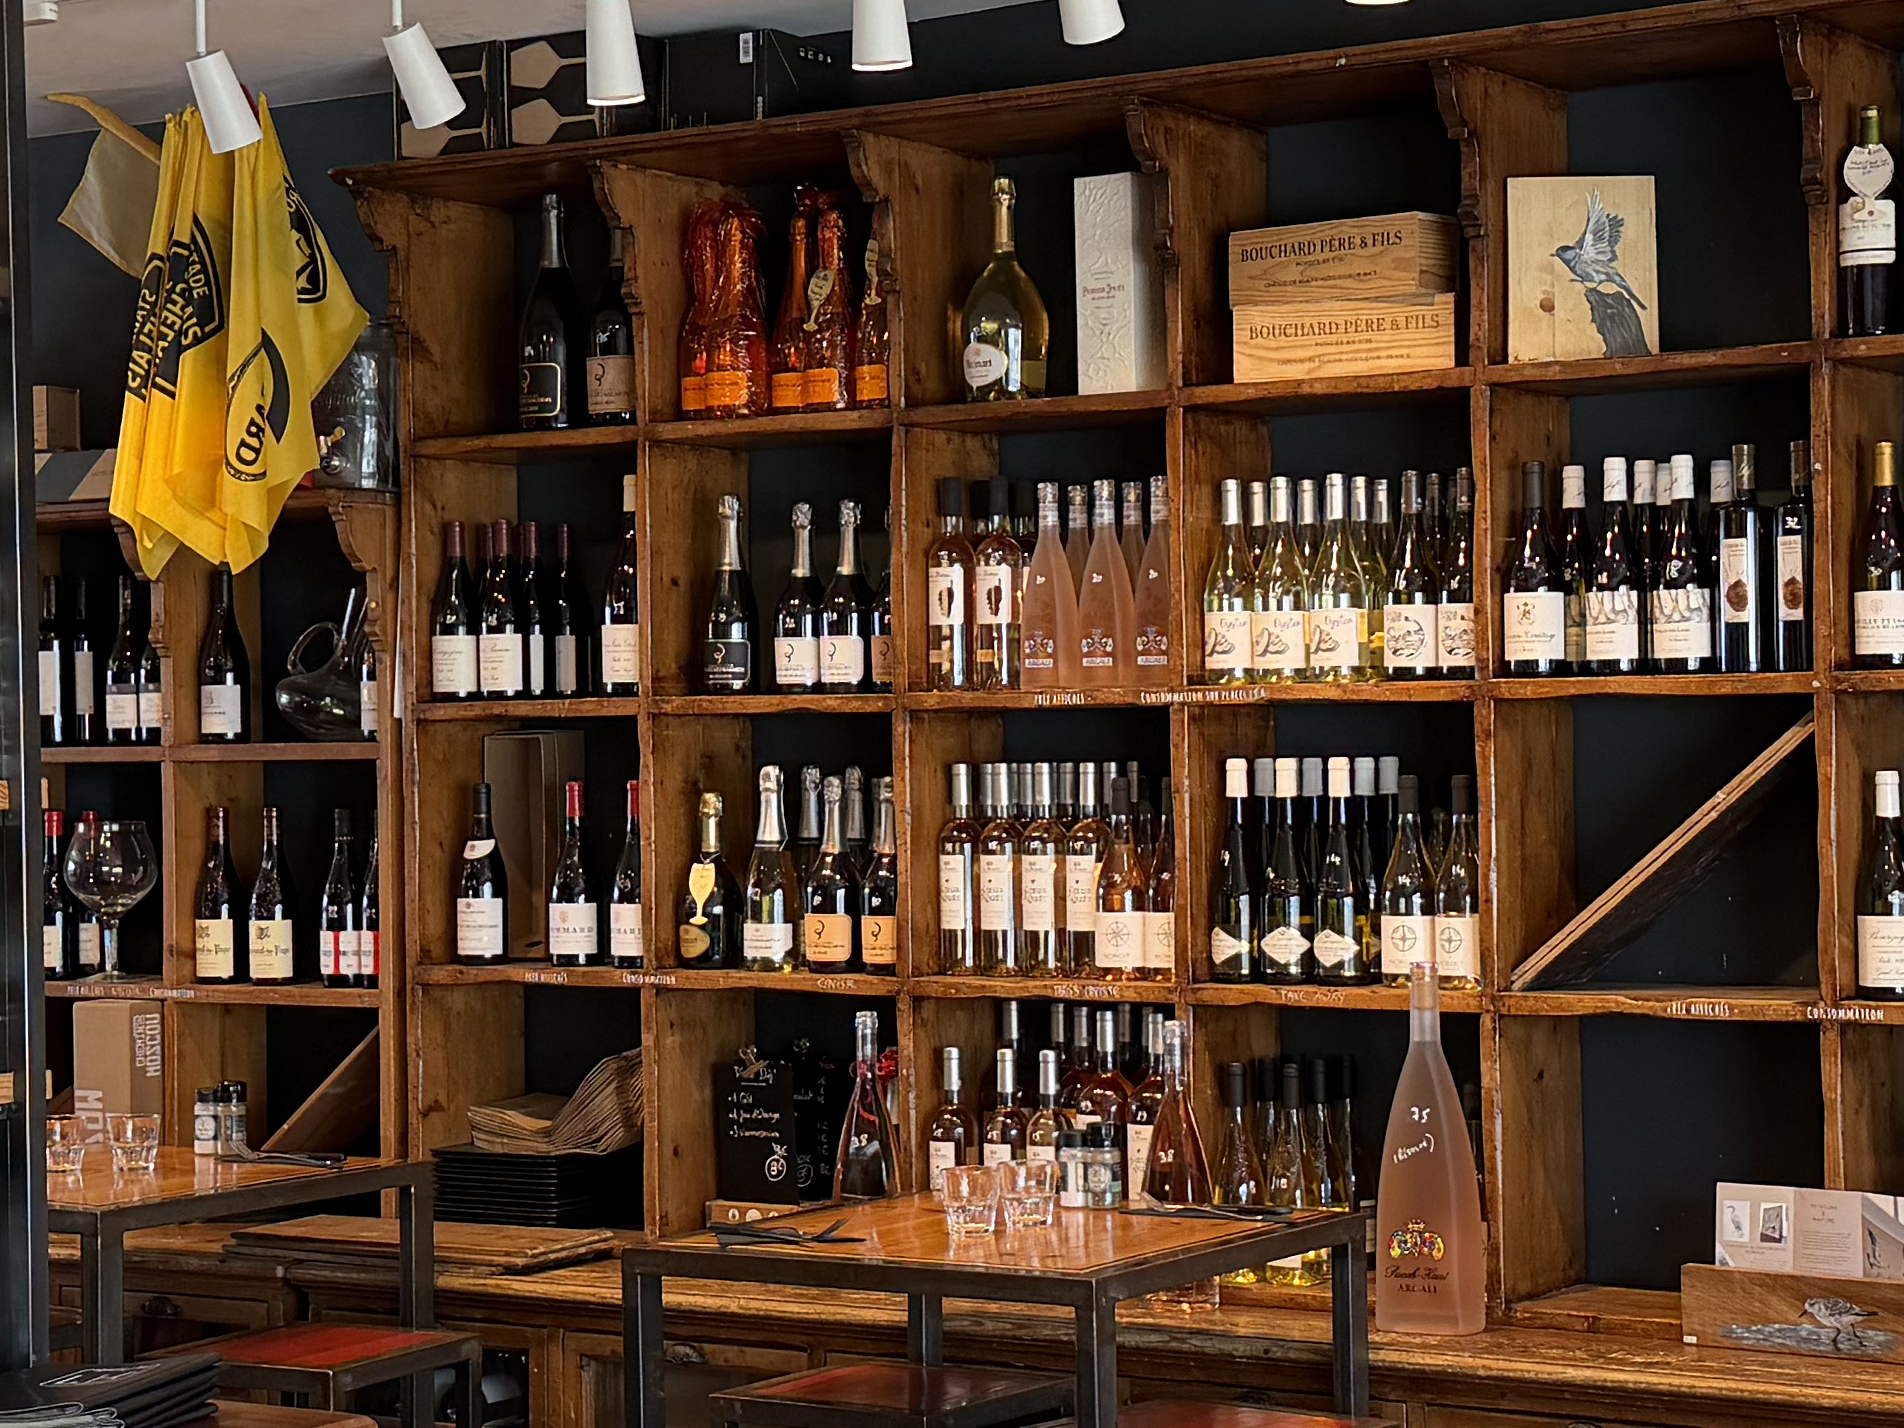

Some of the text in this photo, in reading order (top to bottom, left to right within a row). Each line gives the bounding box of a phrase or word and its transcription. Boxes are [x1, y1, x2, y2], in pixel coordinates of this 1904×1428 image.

[1241, 241, 1316, 263] BOUCHARD
[1320, 235, 1356, 254] PÈRE
[1360, 236, 1368, 249] &
[1371, 230, 1403, 247] FILS
[1249, 314, 1440, 340] BOUCHARD PÈRE & FILS
